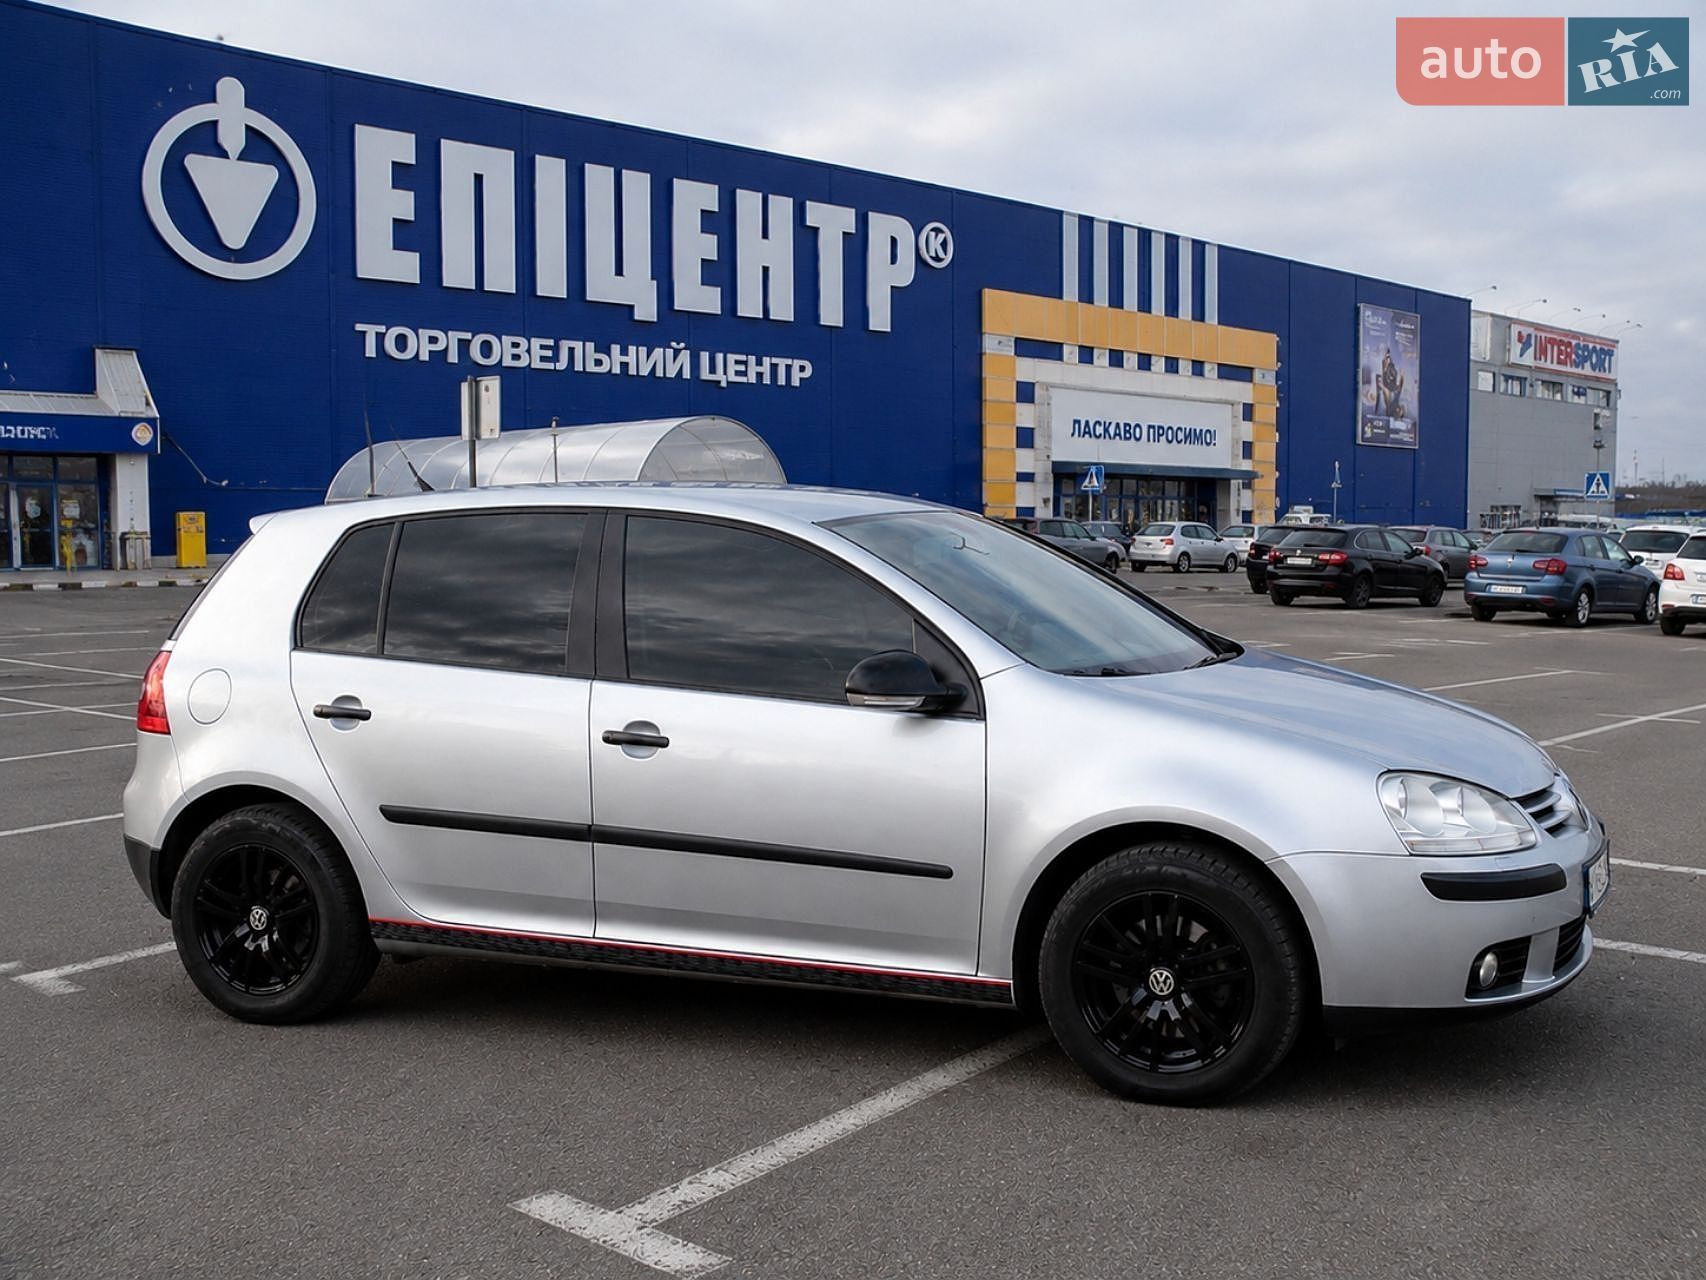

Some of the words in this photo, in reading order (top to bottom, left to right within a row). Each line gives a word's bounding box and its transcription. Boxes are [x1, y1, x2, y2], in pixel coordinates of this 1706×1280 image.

[355, 123, 916, 332] ЕПІЦЕНТР
[354, 322, 691, 379] ТОРГОВЕЛЬНИЙ
[699, 350, 813, 388] ЦЕНТР
[1533, 333, 1615, 374] INTERSPORT
[1071, 418, 1143, 443] ЛАСКАВО
[1146, 424, 1218, 447] ПРОСИМО!
